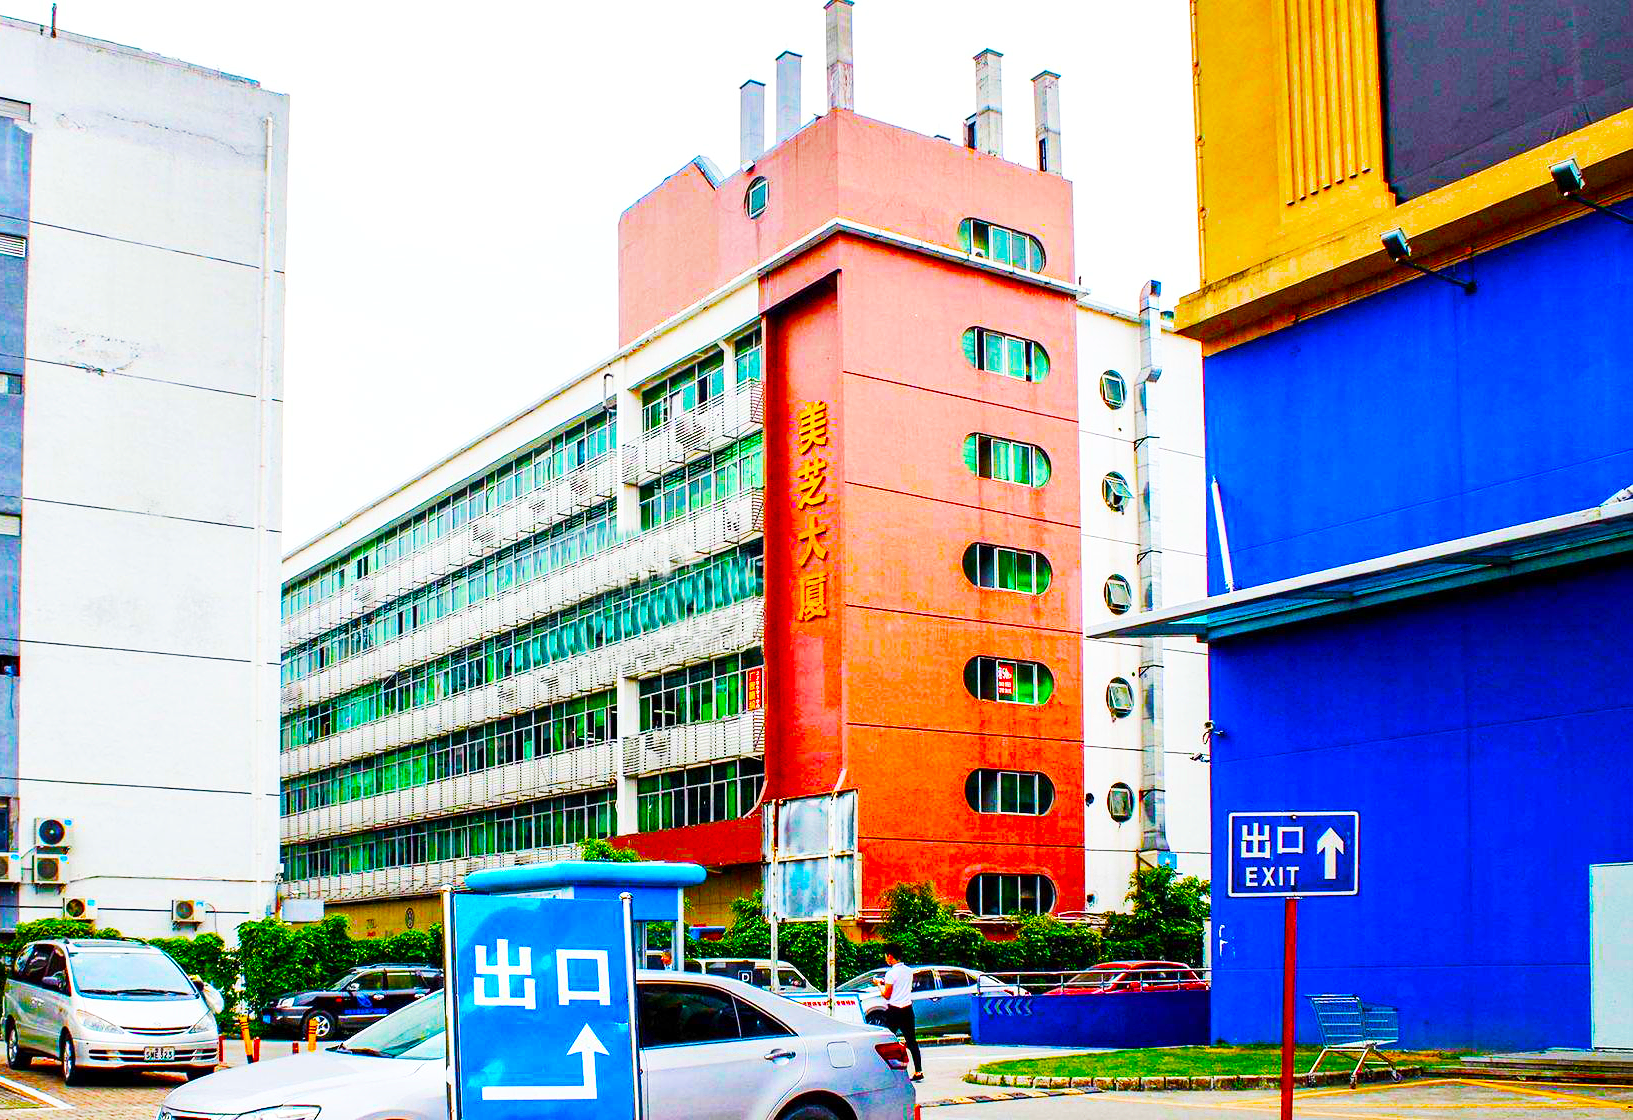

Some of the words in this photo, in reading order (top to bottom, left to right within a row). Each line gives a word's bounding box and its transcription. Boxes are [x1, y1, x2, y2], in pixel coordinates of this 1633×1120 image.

[798, 400, 828, 621] 美芝大厦
[1241, 823, 1304, 859] 出口
[1245, 867, 1300, 887] EXIT
[473, 939, 611, 1010] 出口
